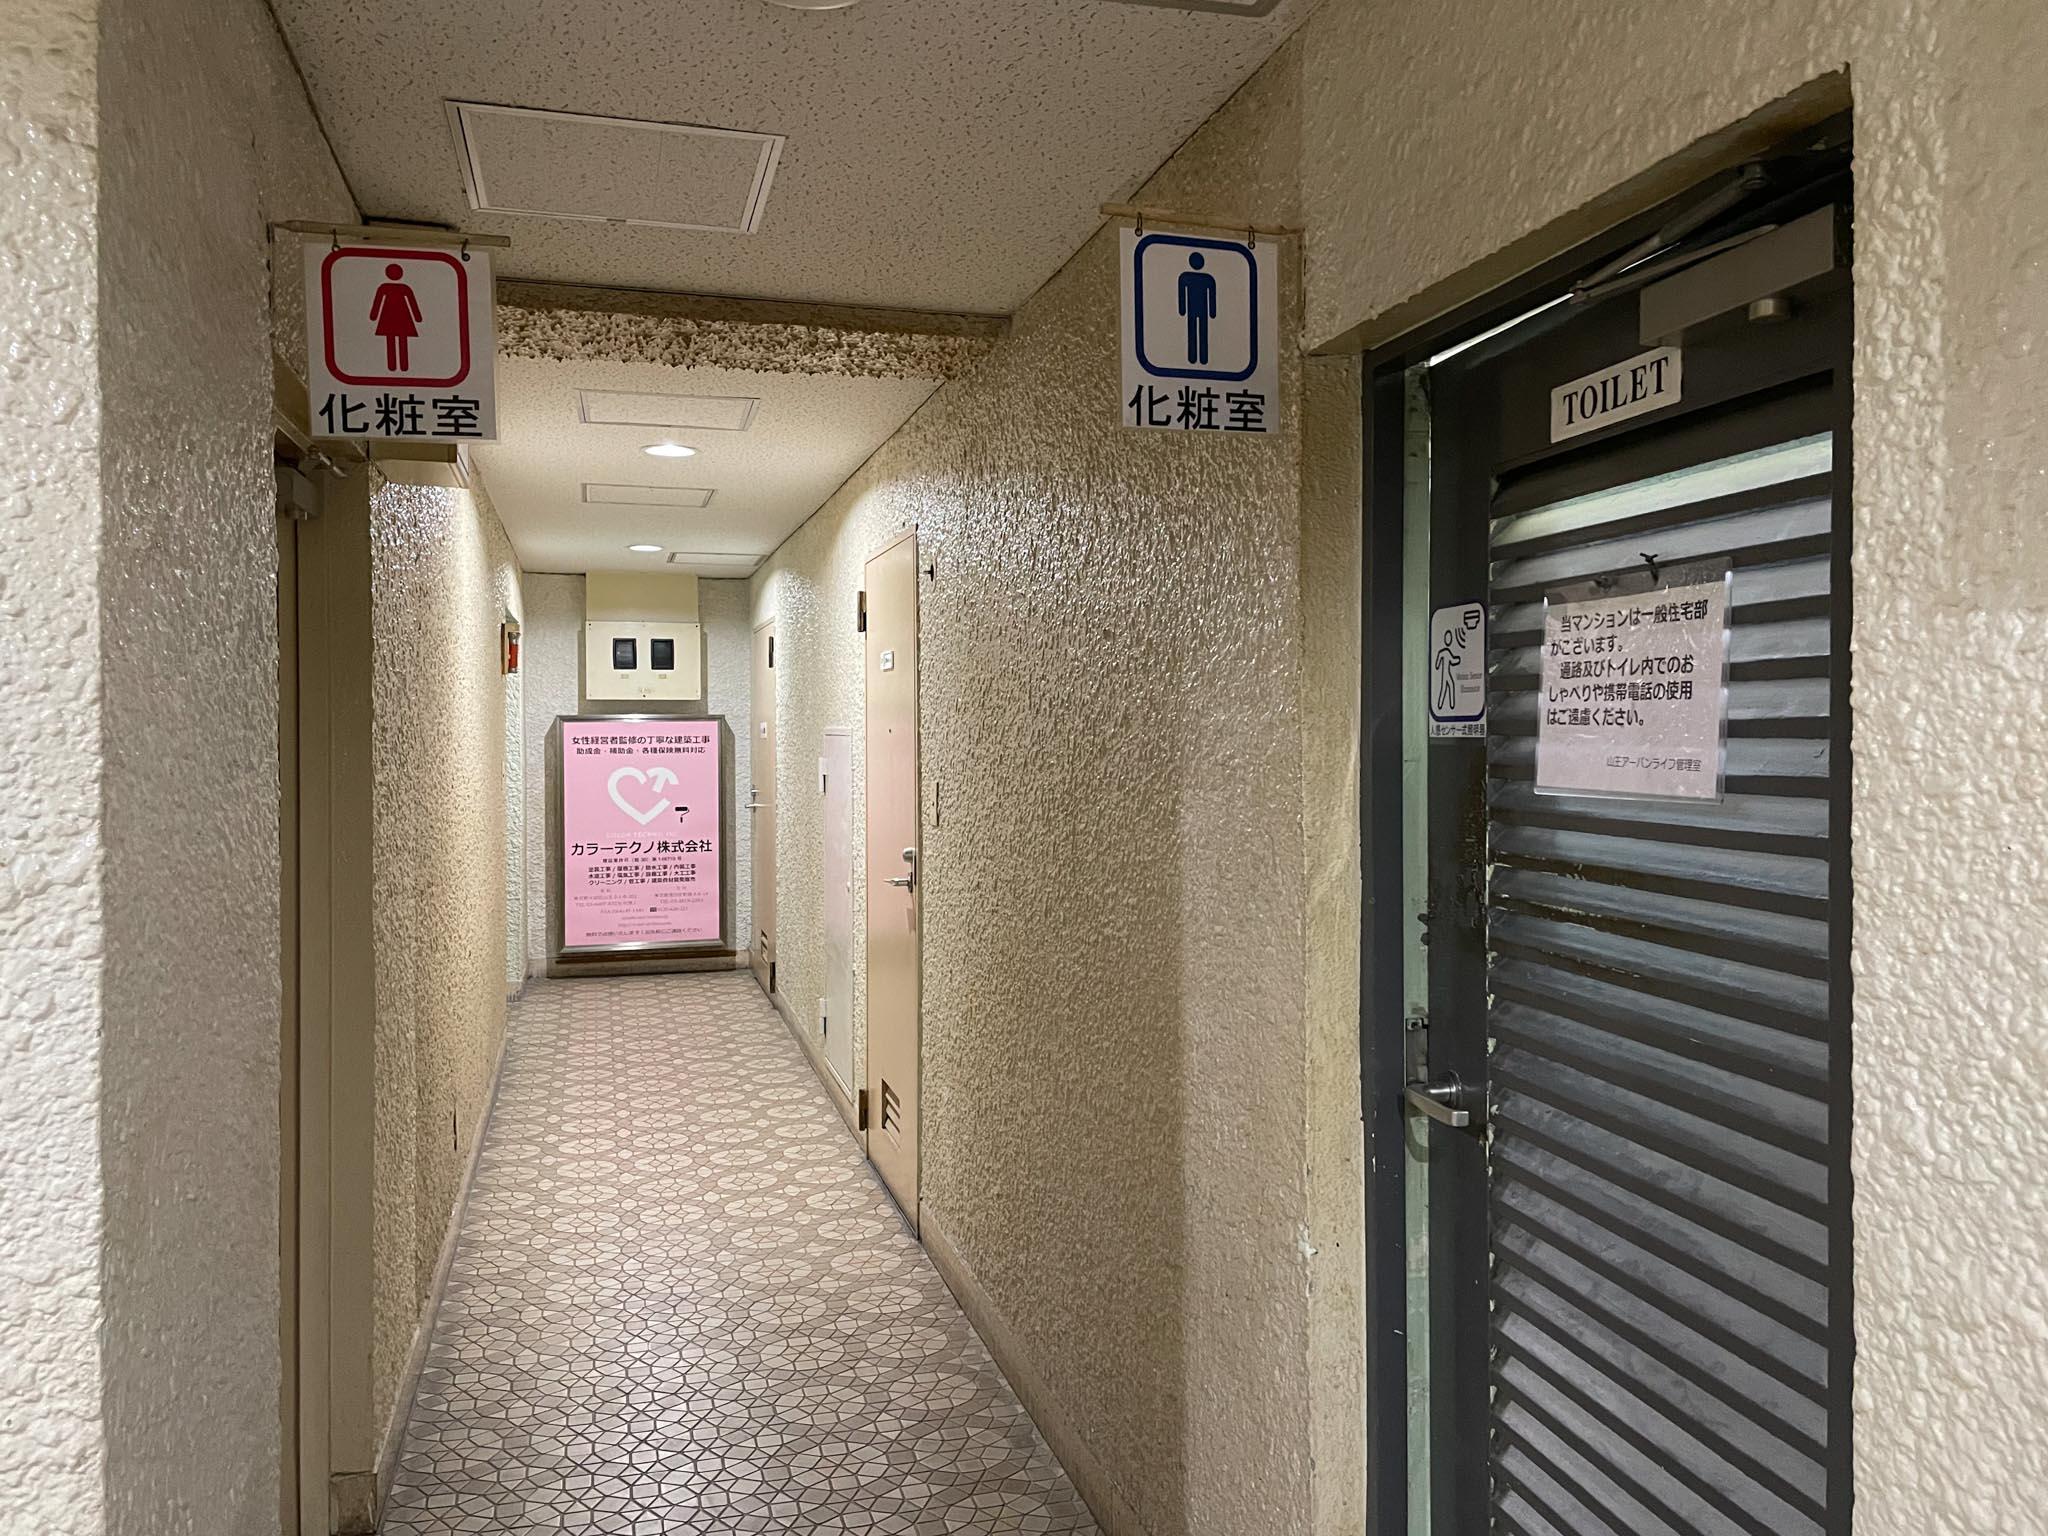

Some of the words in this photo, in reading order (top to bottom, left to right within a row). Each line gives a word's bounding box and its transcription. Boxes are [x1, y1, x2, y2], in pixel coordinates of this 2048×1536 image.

[1563, 357, 1669, 426] TOILET
[319, 393, 483, 437] 化粧室
[1128, 384, 1267, 433] 化粧室
[1561, 599, 1709, 633] 当マンションは一般住宅部
[1559, 654, 1695, 680] 通路及びトイレ内でのお
[1548, 680, 1693, 703] しゃべりや携帯電話の使用
[1546, 708, 1644, 727] はご遠慮ください。
[1606, 755, 1703, 772] 山王アーバンライフ管理室
[571, 839, 713, 856] カラーテクノ株式会社
